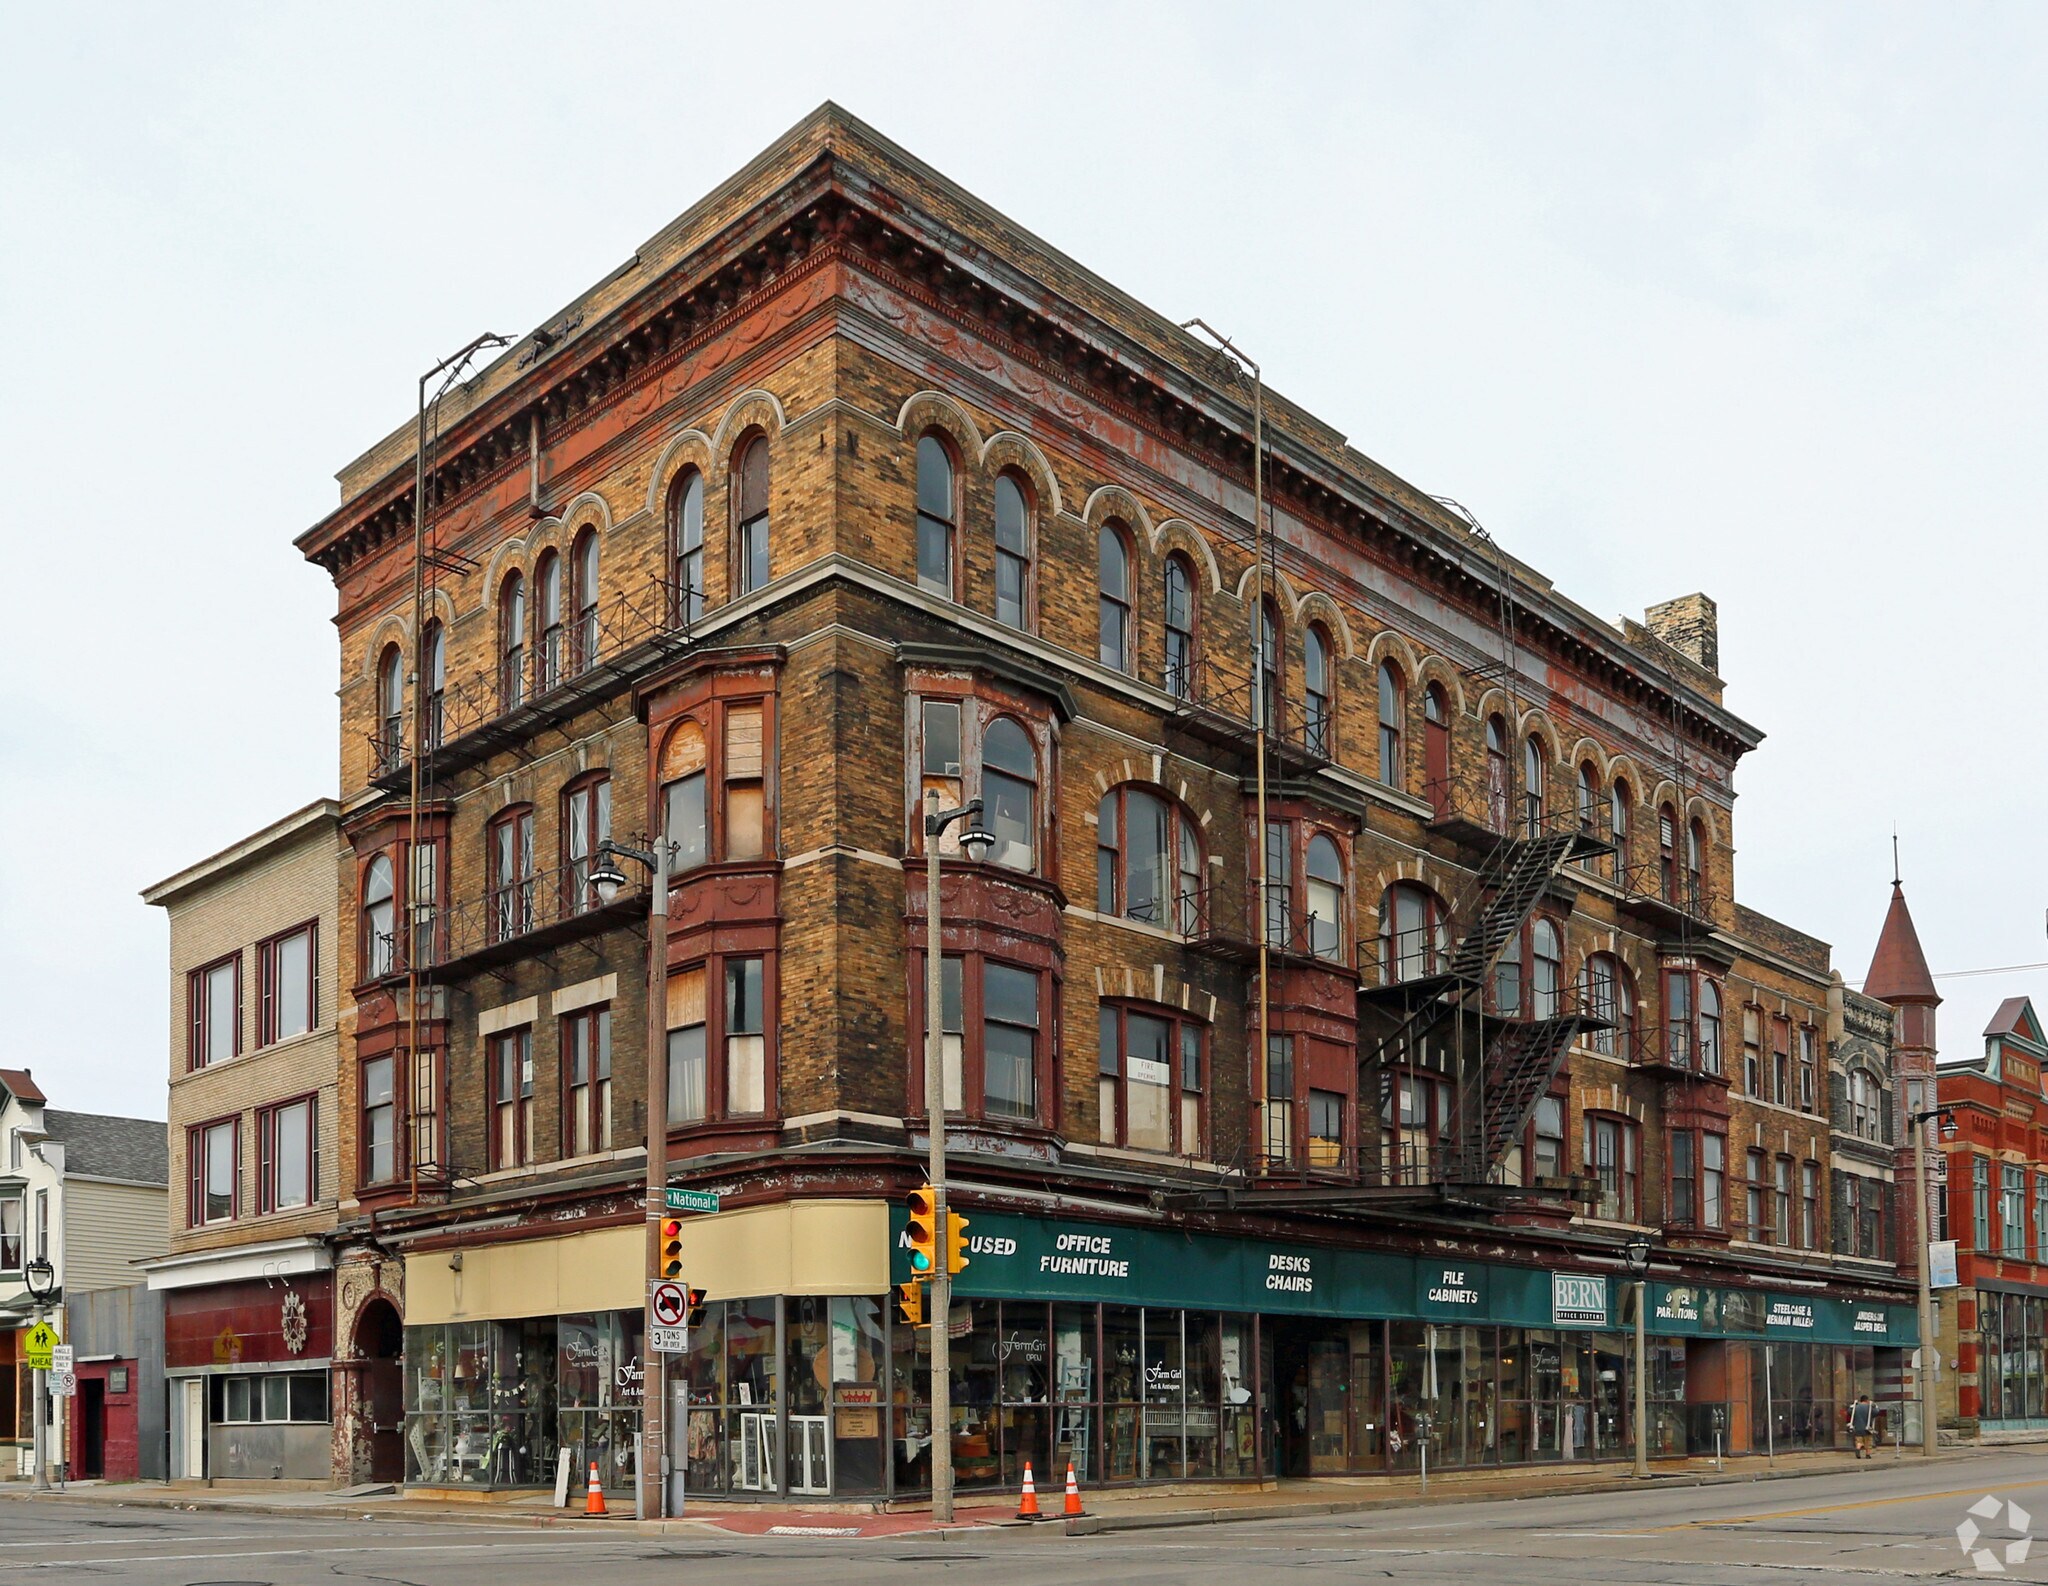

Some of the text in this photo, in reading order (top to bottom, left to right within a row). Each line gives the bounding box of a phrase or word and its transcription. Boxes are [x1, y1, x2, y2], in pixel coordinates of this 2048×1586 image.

[1141, 1061, 1154, 1070] FIRE
[673, 1192, 711, 1208] National
[970, 1235, 1017, 1256] USED
[1056, 1234, 1111, 1254] OFFICE
[1040, 1255, 1129, 1277] FURNITURE
[1269, 1254, 1311, 1272] DESKS
[1265, 1274, 1313, 1292] CHAIRS
[1442, 1271, 1465, 1285] FILE
[1428, 1288, 1478, 1304] CABINETS
[1556, 1279, 1603, 1309] BERN
[1579, 1313, 1603, 1321] SYSTEMS
[1656, 1306, 1698, 1320] PARTIONS
[1773, 1303, 1806, 1316] STEELCASE
[654, 1331, 680, 1345] 3 TONS
[1026, 1353, 1042, 1362] OPEN
[1145, 1360, 1182, 1382] Farm Girl
[622, 1388, 630, 1396] Art
[1162, 1383, 1180, 1391] Antiques
